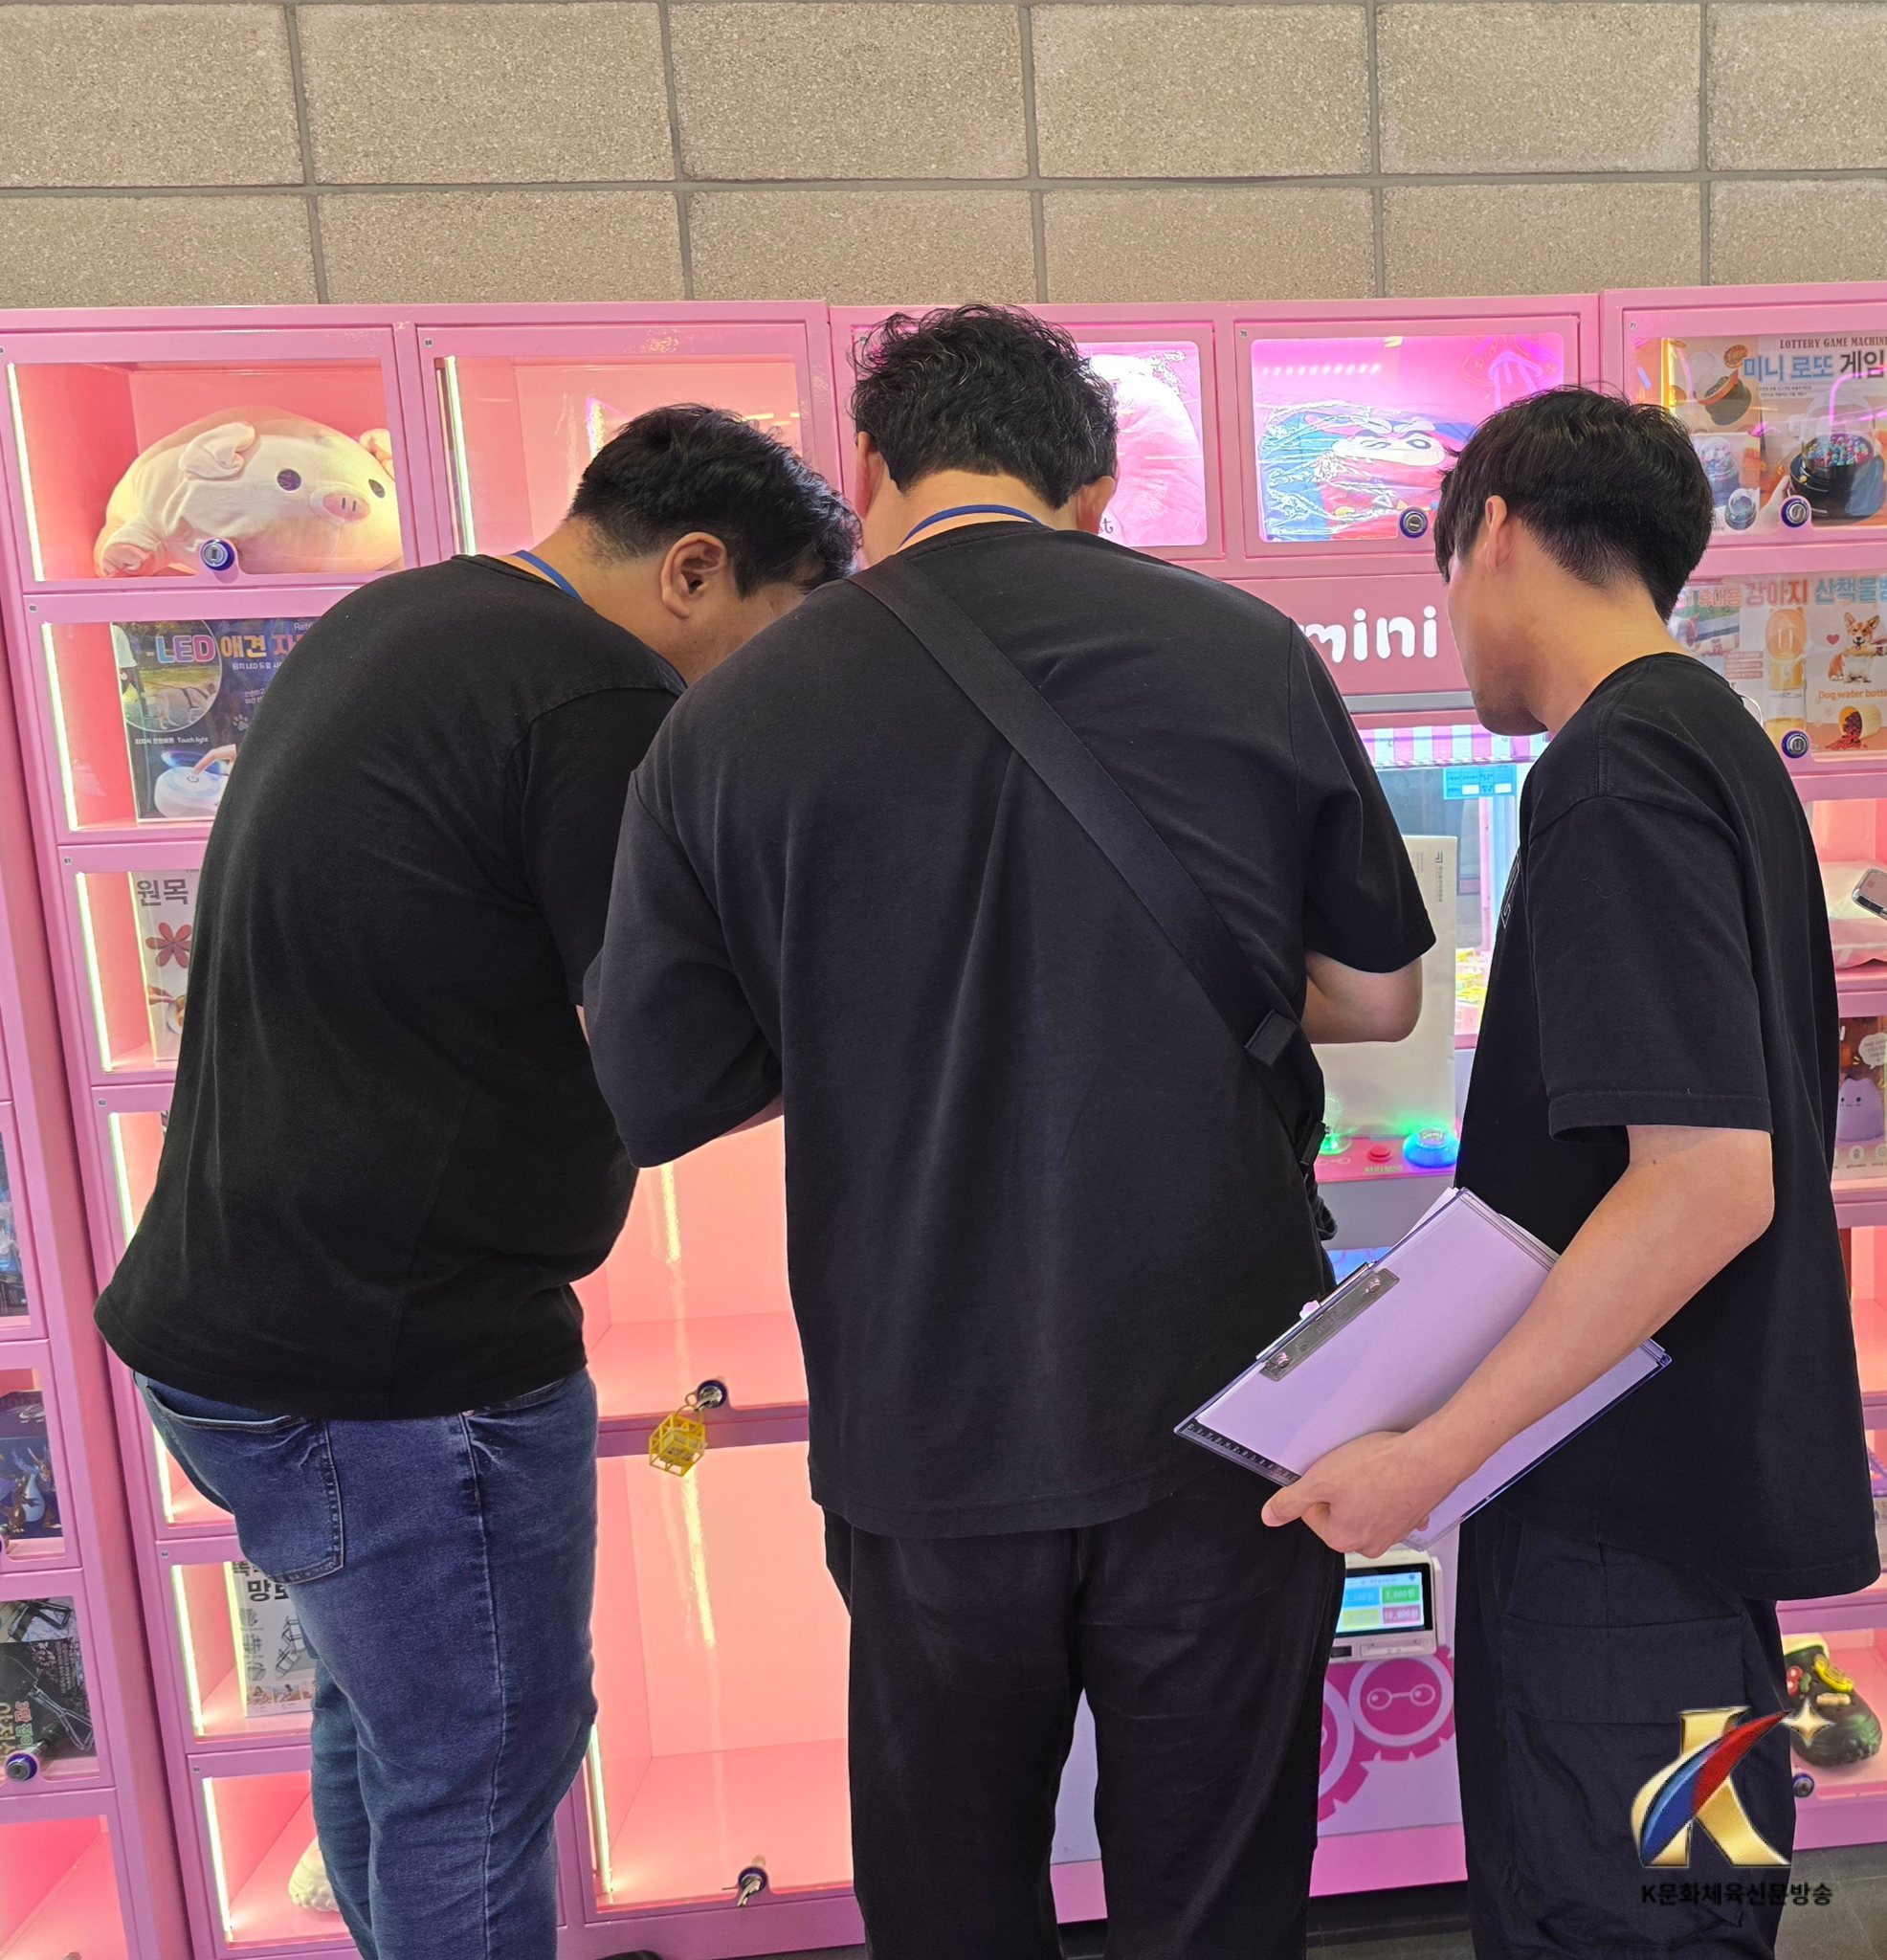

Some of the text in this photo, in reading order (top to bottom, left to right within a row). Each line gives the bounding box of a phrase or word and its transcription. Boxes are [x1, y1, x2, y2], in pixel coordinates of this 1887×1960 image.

[1780, 338, 1821, 349] LOTTERY
[1823, 337, 1849, 347] GAME
[1743, 350, 1885, 382] 미니 로또 게임
[1745, 579, 1809, 607] 강아지
[155, 635, 216, 664] LED
[220, 635, 267, 658] 애견
[1818, 690, 1836, 701] Dog
[136, 879, 189, 906] 원목
